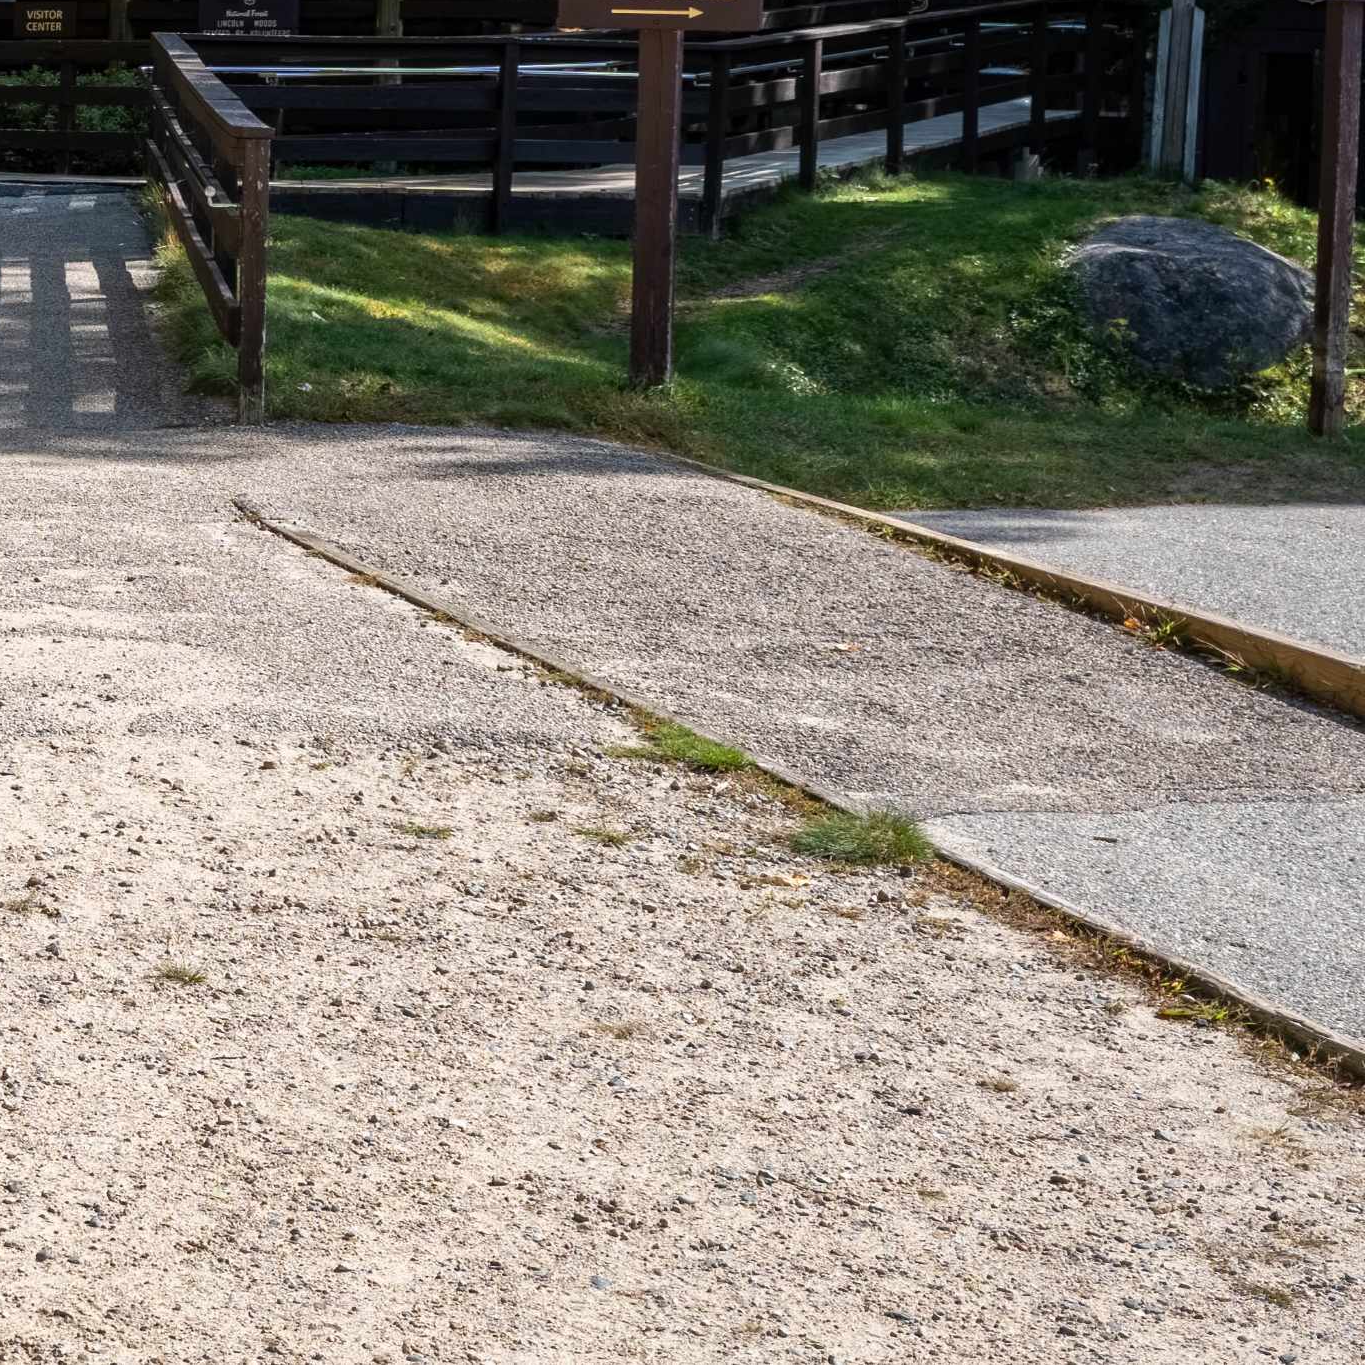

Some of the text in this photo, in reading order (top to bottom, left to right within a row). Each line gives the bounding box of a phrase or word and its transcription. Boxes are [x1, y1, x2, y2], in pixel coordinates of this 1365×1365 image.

[26, 10, 63, 20] VISITOR
[25, 22, 61, 31] CENTER
[254, 19, 277, 27] WOODS
